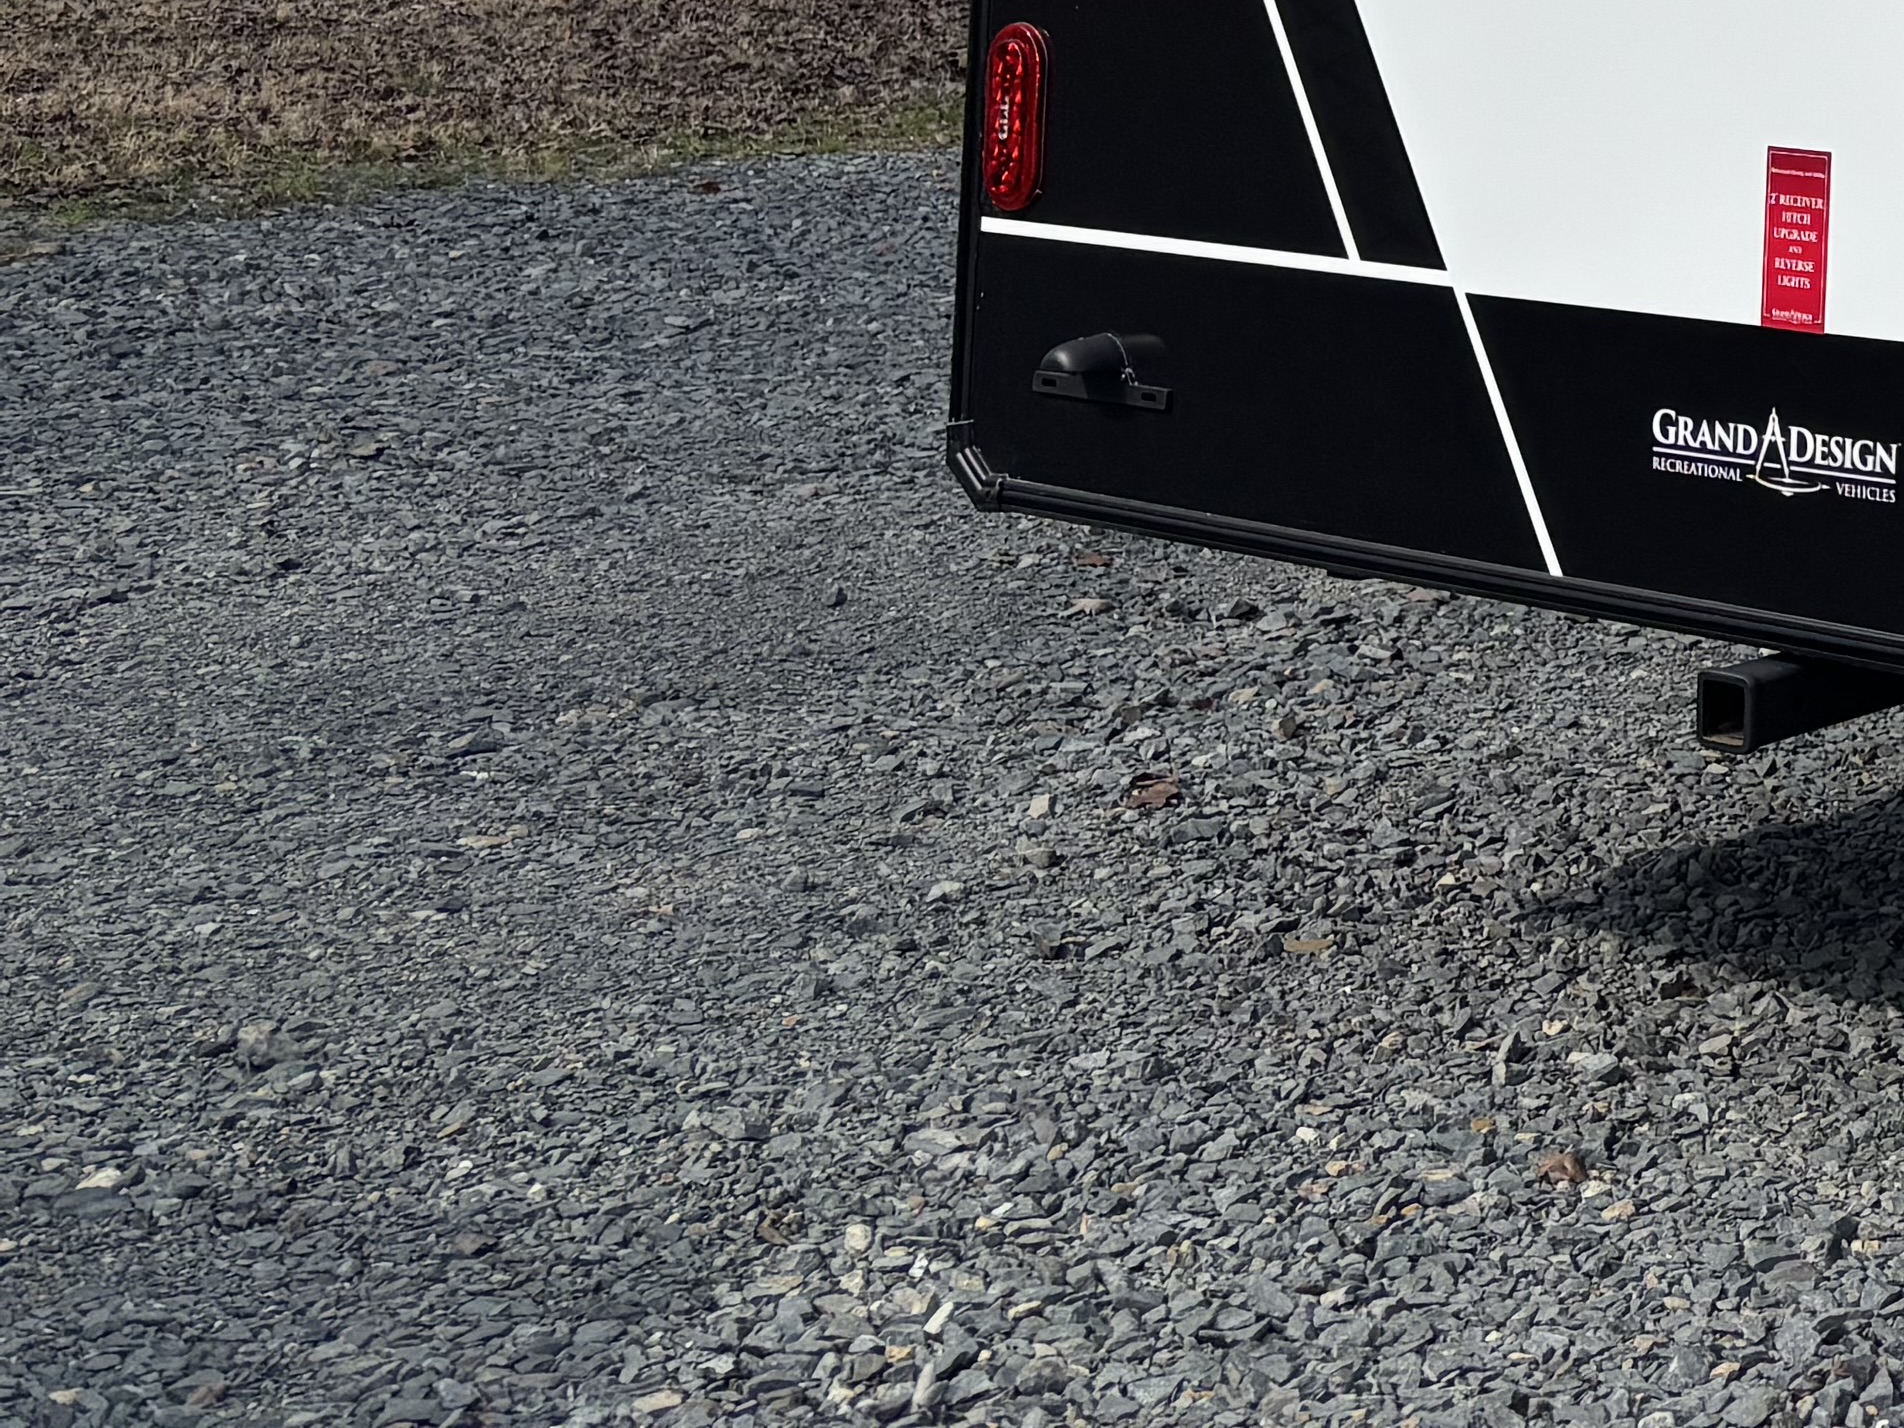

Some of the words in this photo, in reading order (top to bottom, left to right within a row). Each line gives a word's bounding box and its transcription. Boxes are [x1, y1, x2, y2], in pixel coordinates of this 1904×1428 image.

[1773, 226, 1818, 242] UPGRADE
[1774, 257, 1815, 272] REVERSE
[1777, 274, 1811, 289] LIGHTS
[1652, 456, 1743, 482] RECREATIONAL
[1836, 481, 1896, 503] VEHICLES
